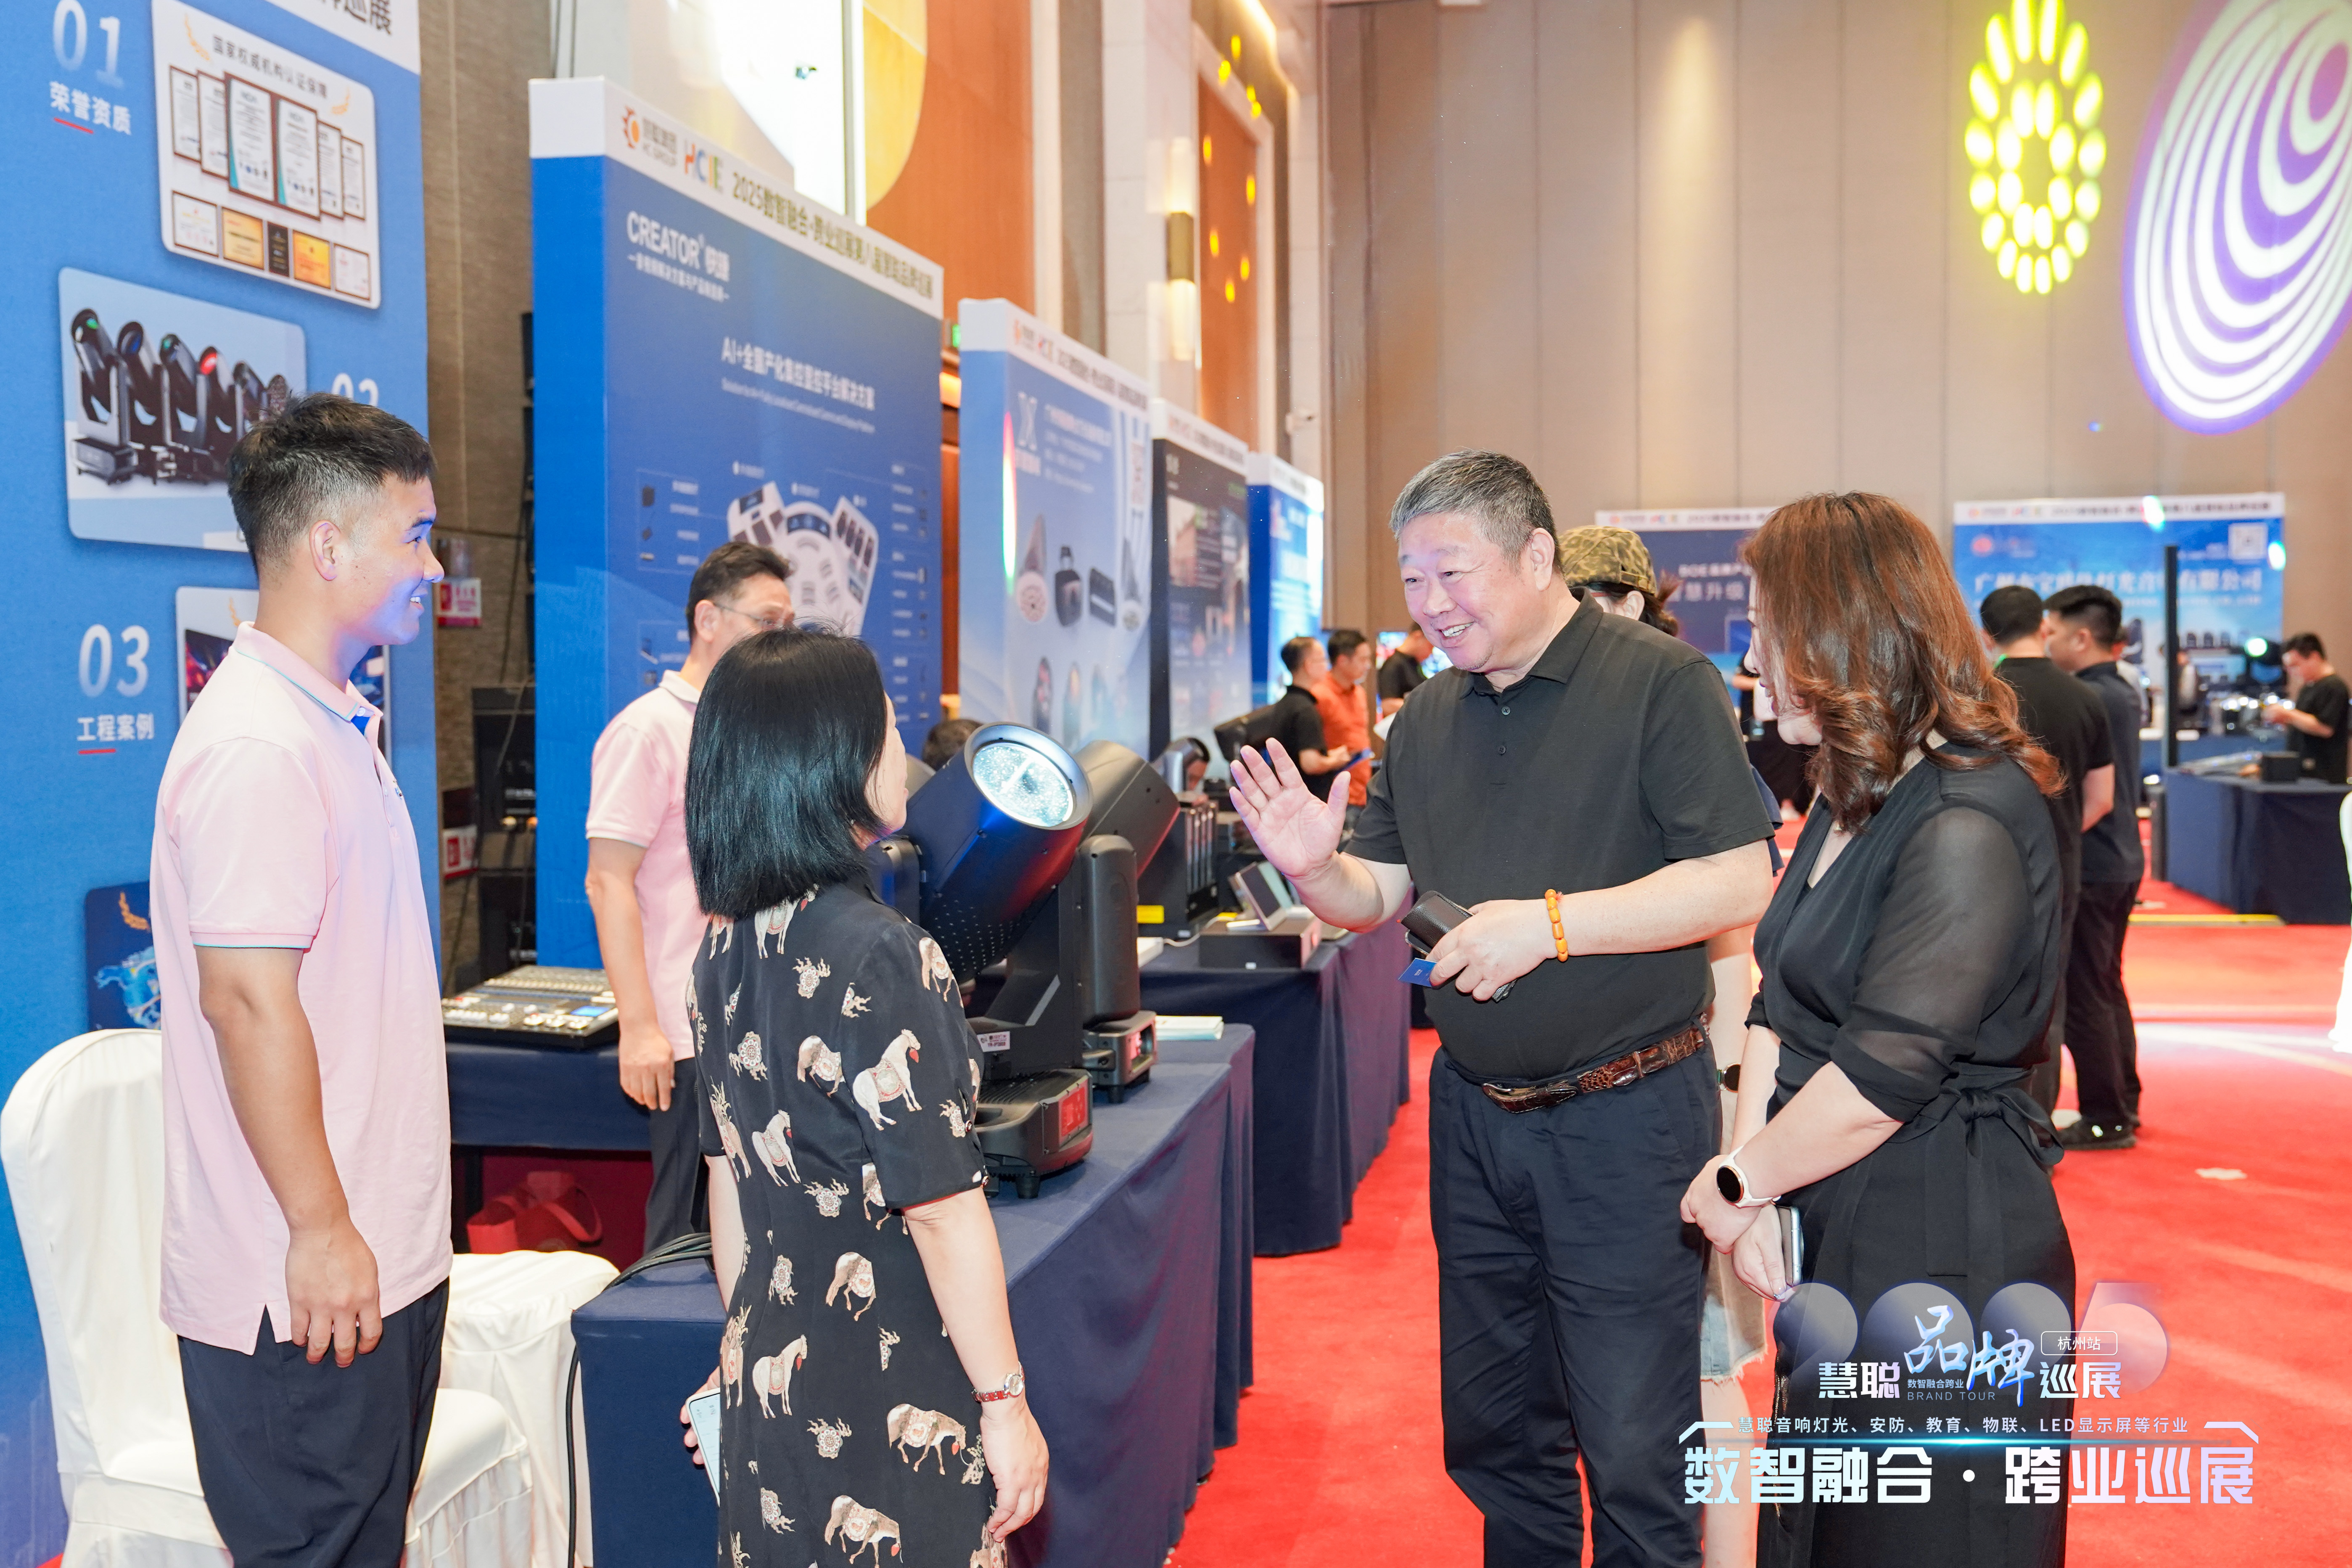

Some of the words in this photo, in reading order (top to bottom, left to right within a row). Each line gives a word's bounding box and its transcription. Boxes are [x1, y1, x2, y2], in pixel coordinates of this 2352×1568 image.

[53, 0, 124, 87] 01
[49, 81, 132, 135] 荣誉资质
[79, 624, 150, 698] 03
[77, 713, 154, 741] 工程案例
